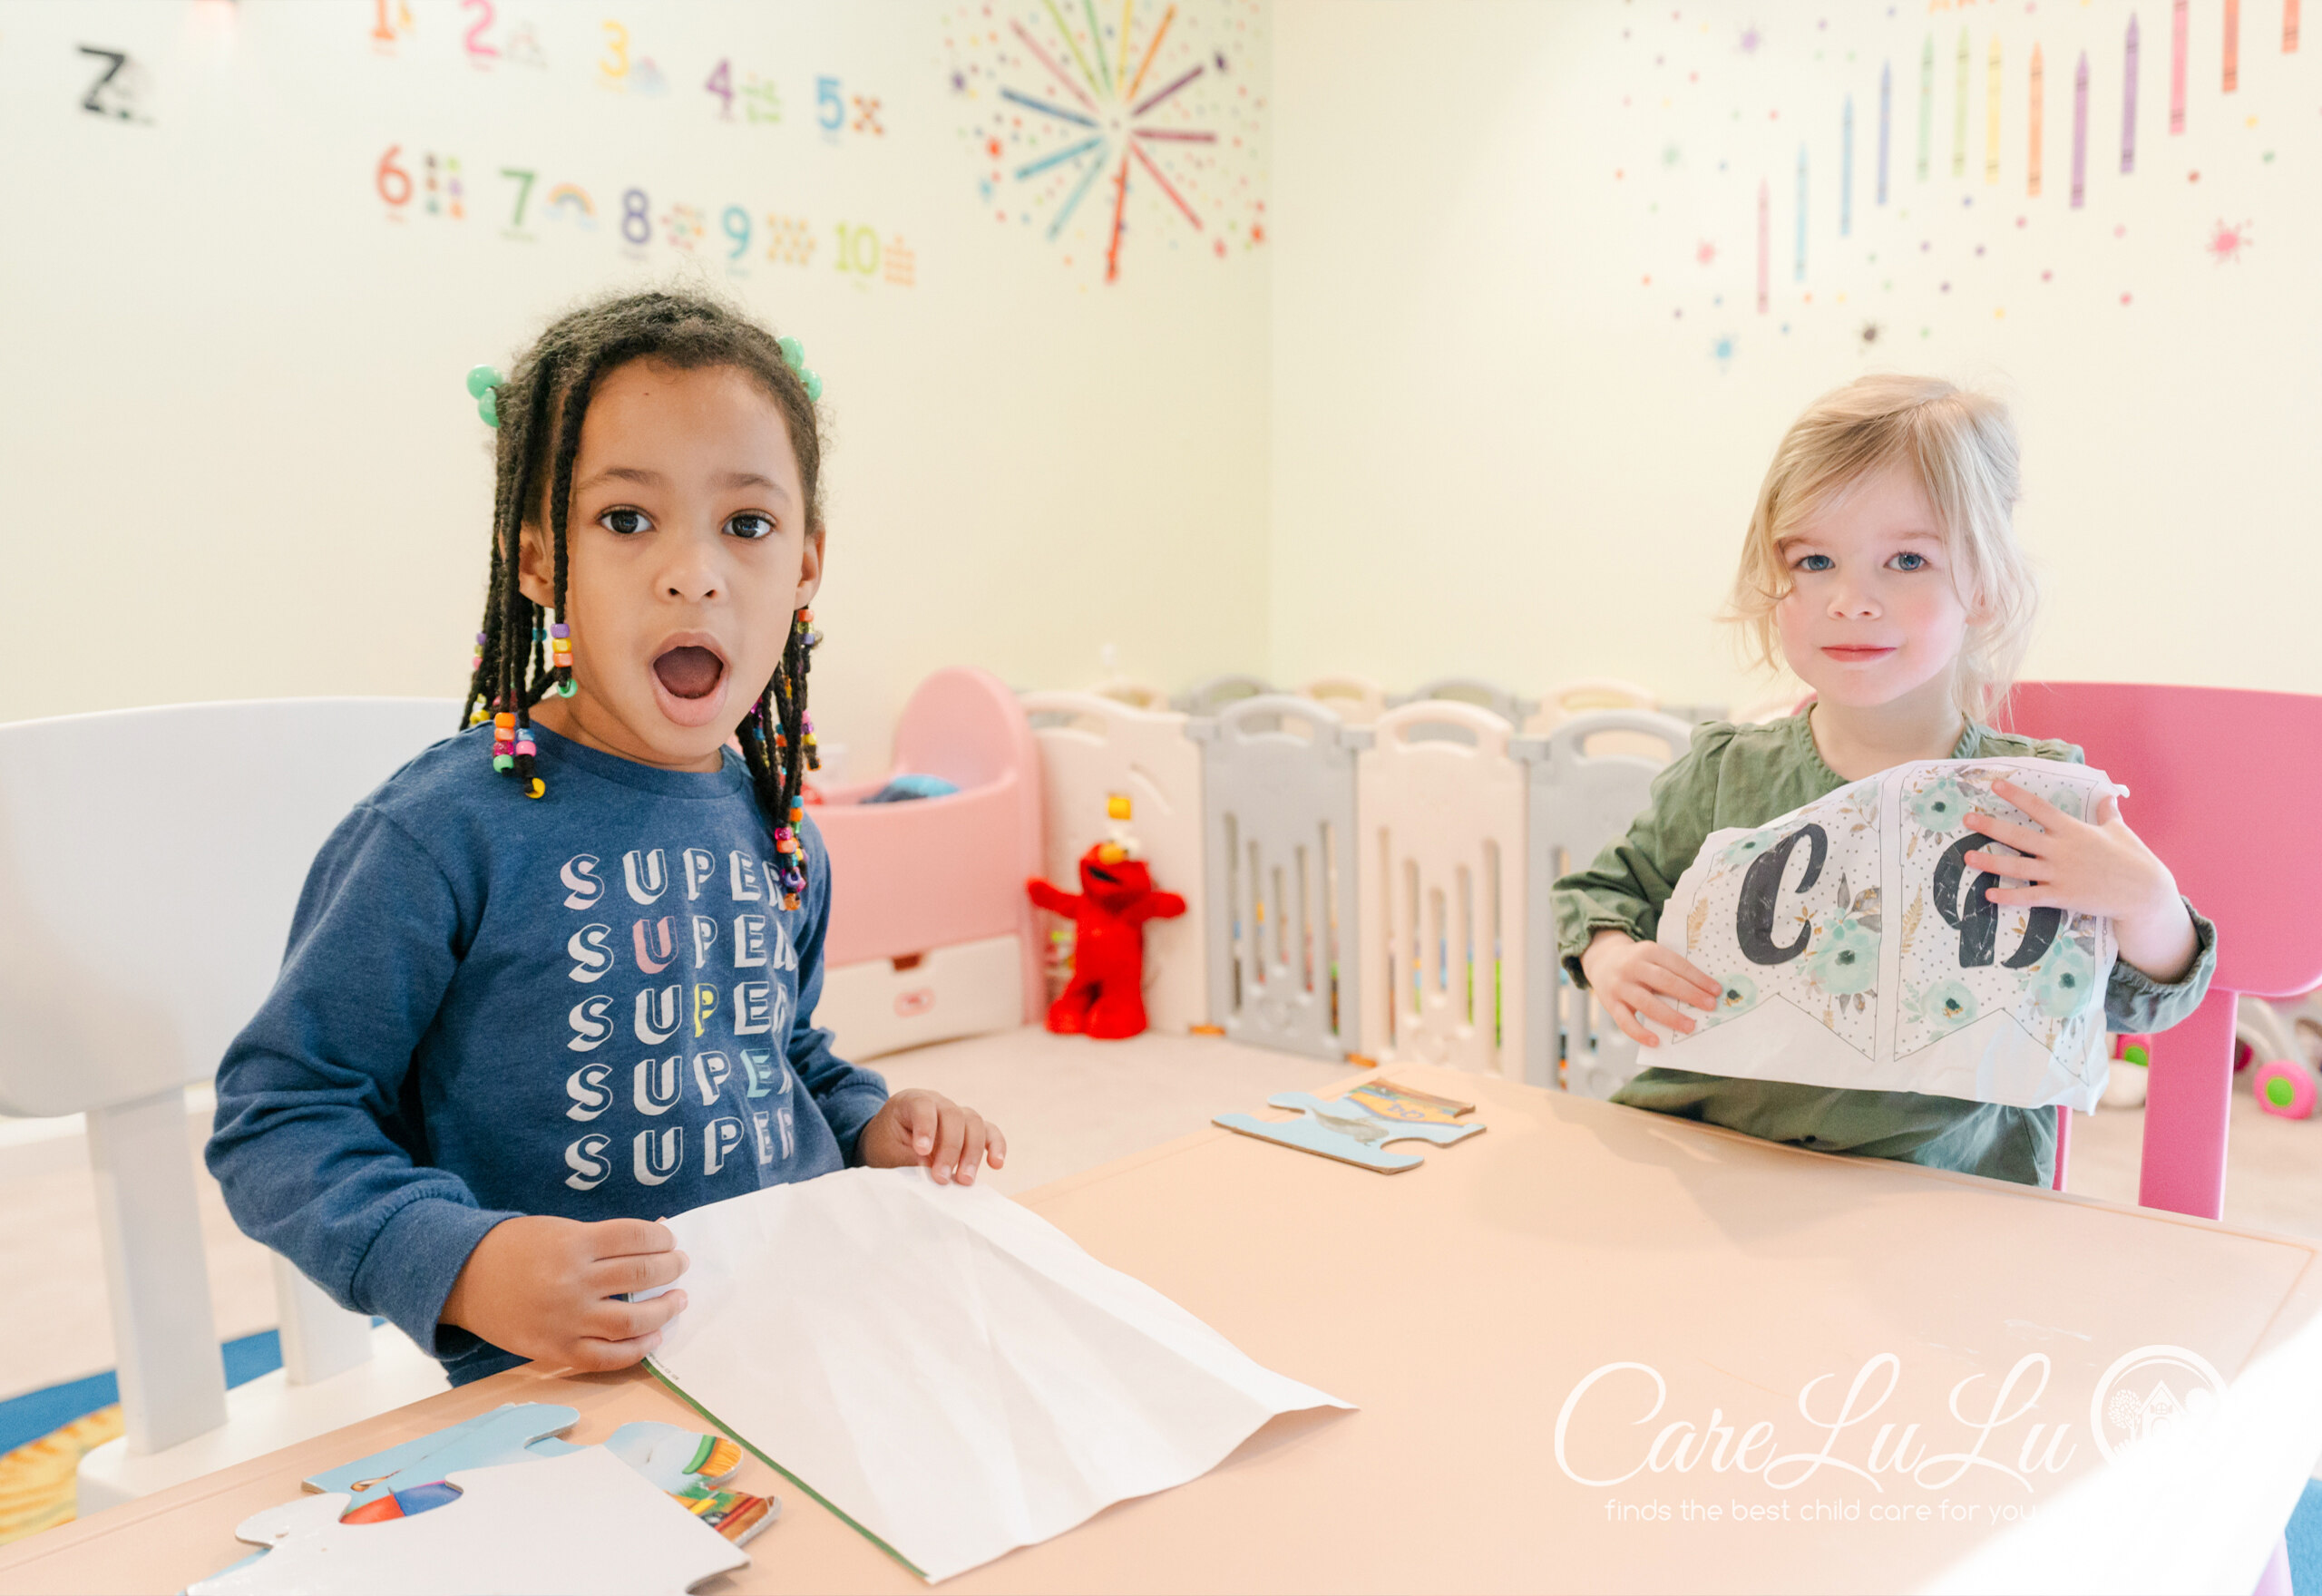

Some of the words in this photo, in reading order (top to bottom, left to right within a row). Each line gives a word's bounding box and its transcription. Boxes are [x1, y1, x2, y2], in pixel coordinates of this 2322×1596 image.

[460, 0, 502, 56] 2
[600, 20, 631, 78] 3
[705, 58, 734, 107] 4
[816, 75, 844, 131] 5
[376, 145, 413, 207] 6
[500, 169, 537, 226] 7
[622, 188, 651, 246] 8
[723, 206, 751, 260] 9
[834, 222, 880, 276] 10
[1736, 822, 1829, 965] C
[564, 1107, 795, 1192] SUPER
